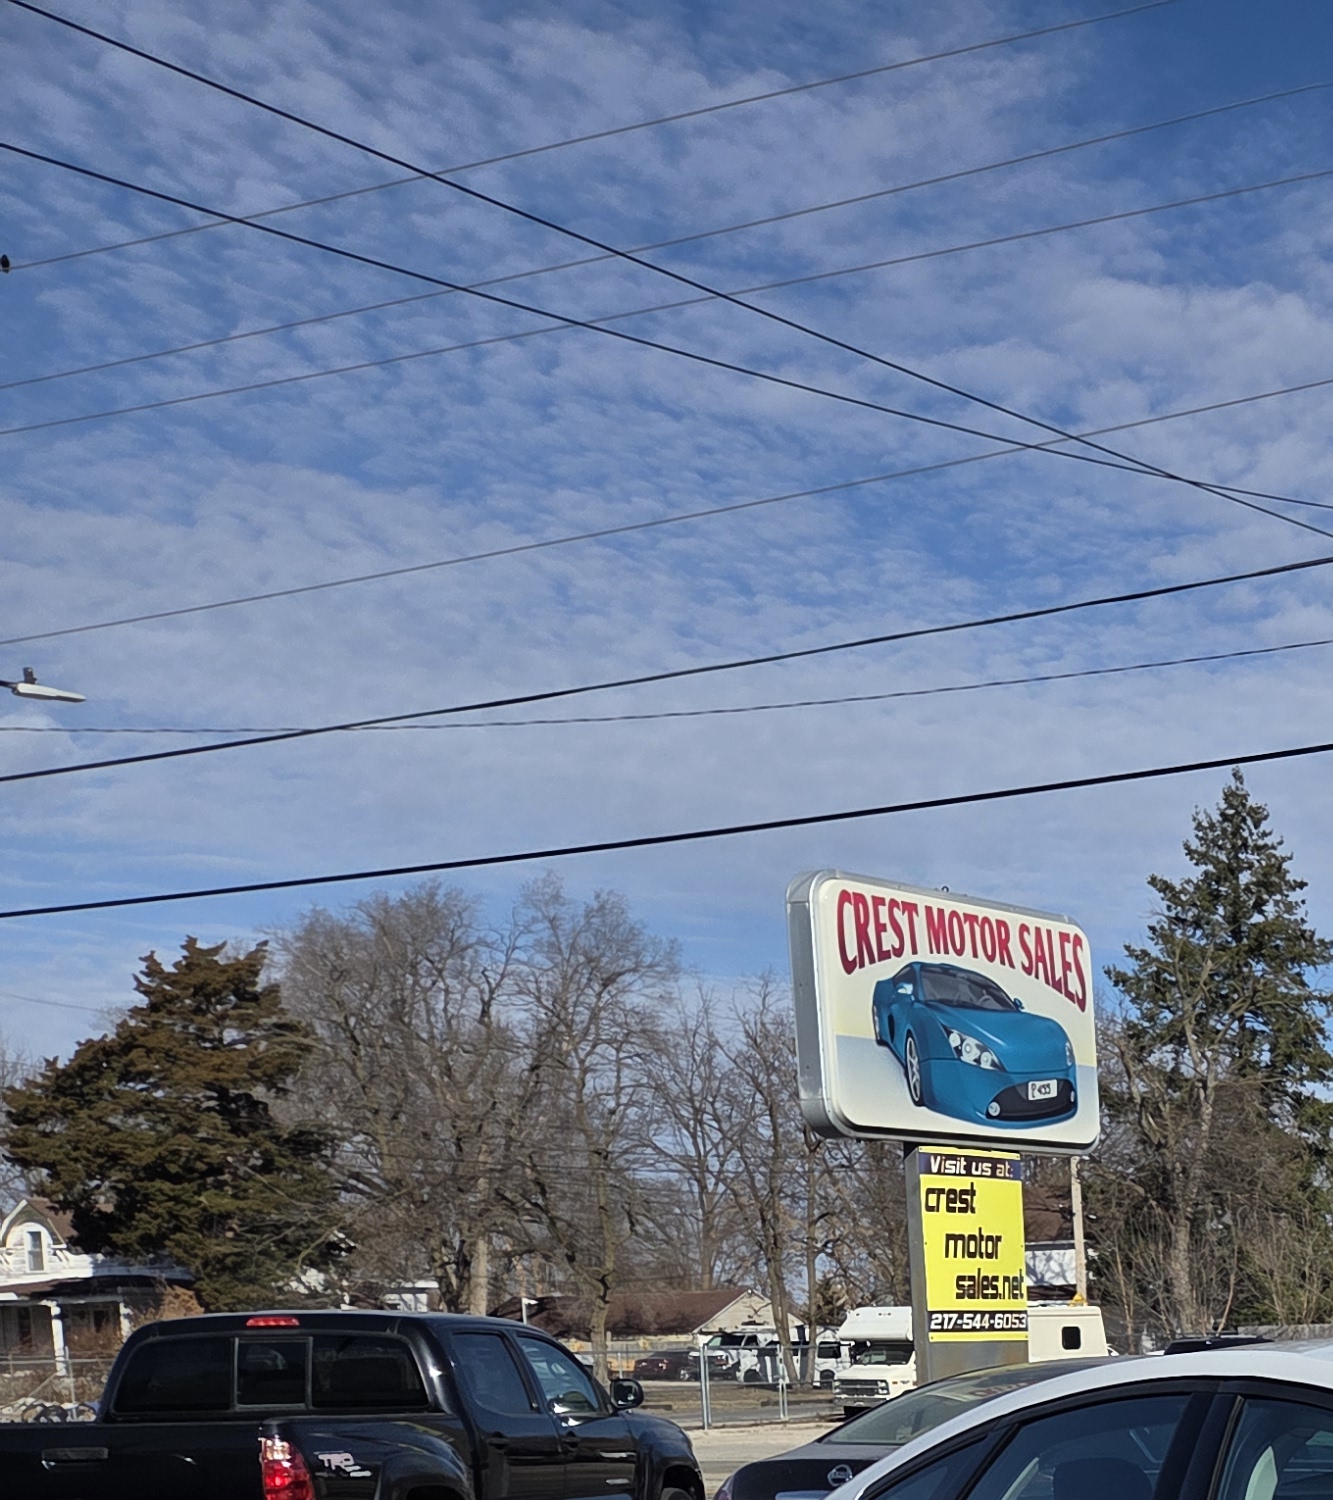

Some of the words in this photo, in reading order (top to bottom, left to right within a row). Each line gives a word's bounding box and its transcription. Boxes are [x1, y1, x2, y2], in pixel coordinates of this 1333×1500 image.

[837, 889, 918, 975] CREST
[924, 905, 1015, 970] MOTOR
[1019, 923, 1087, 1013] SALES
[930, 1155, 968, 1175] Visit
[971, 1161, 992, 1177] us
[996, 1162, 1014, 1178] at:
[925, 1182, 977, 1214] crest
[945, 1227, 1003, 1260] motor
[955, 1268, 1025, 1300] sales.net
[930, 1313, 1027, 1330] 217-544-6053
[318, 1452, 355, 1471] TRD
